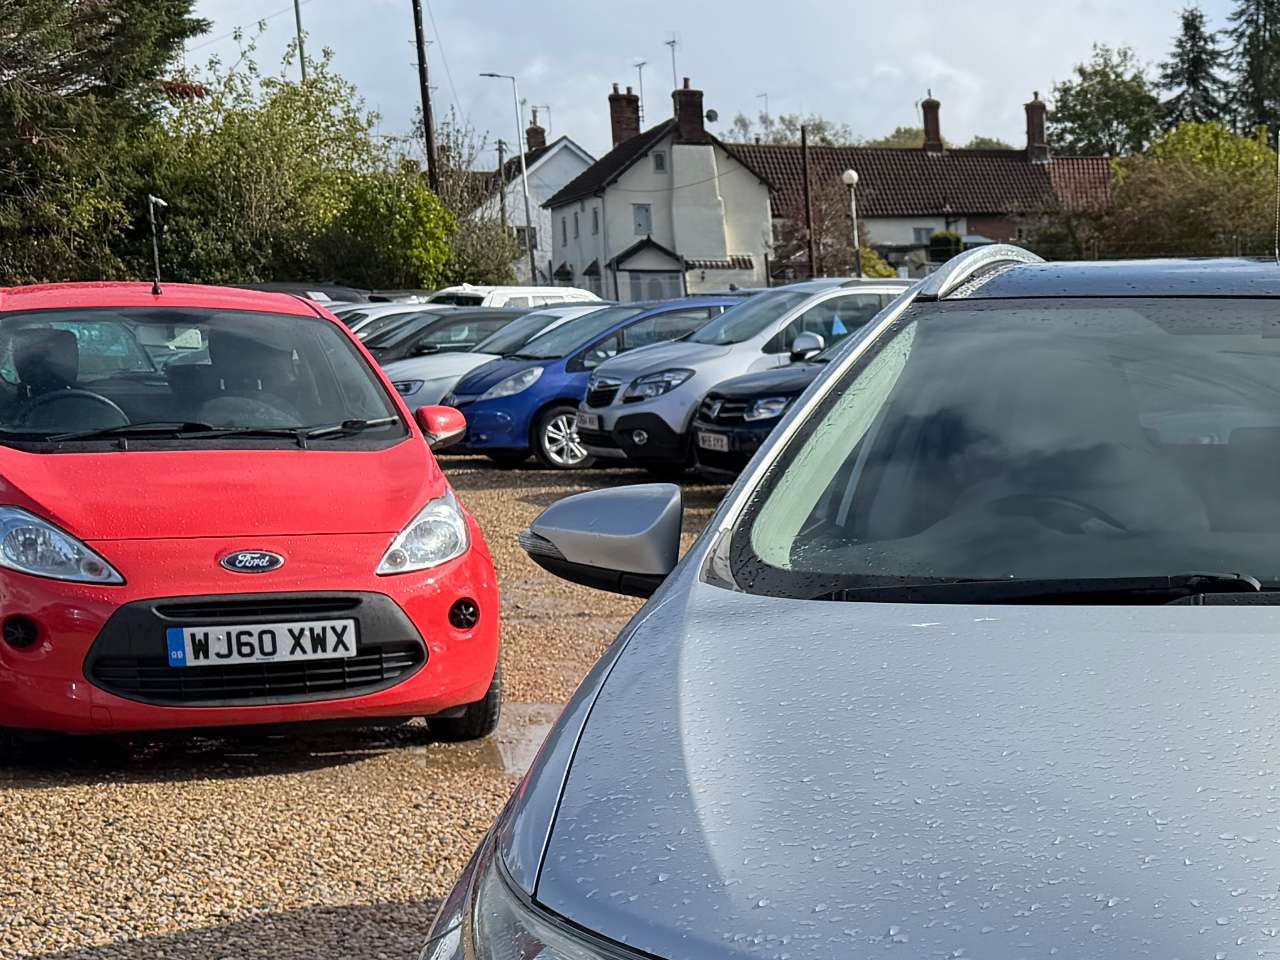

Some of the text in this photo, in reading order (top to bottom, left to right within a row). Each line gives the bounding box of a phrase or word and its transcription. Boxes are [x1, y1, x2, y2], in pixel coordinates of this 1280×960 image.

[235, 553, 270, 568] Ford
[190, 625, 350, 660] WJ60 XWX
